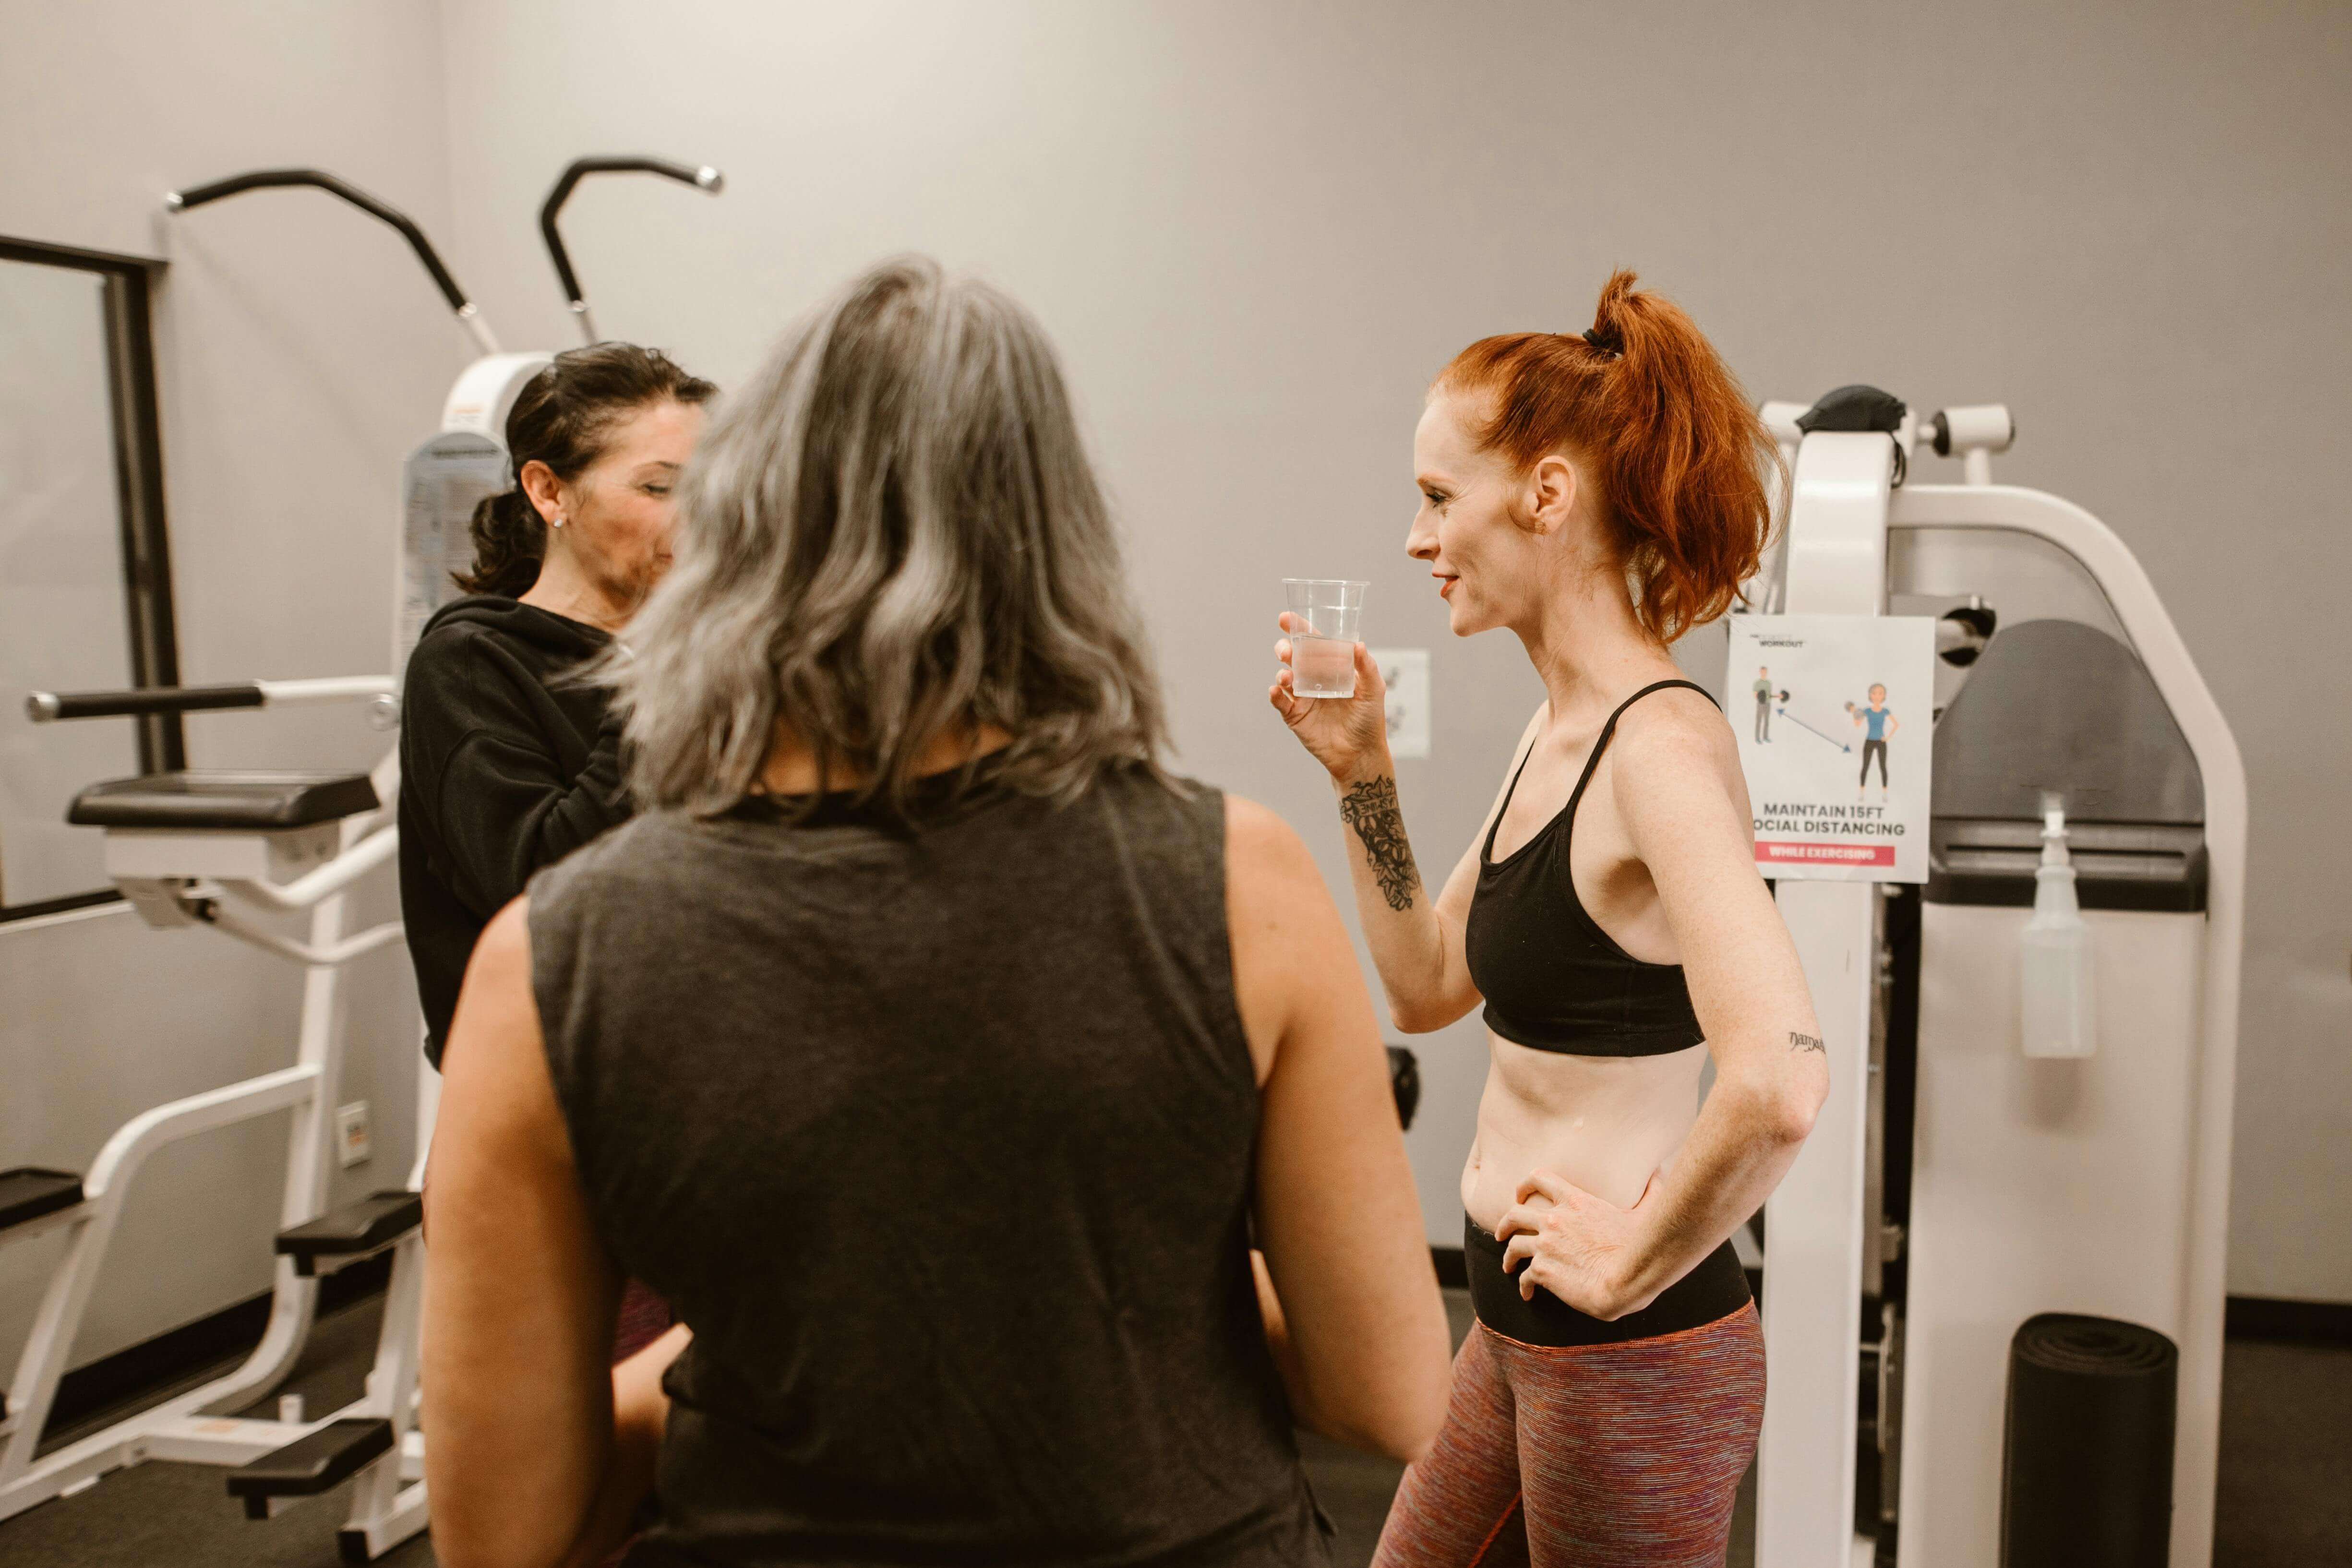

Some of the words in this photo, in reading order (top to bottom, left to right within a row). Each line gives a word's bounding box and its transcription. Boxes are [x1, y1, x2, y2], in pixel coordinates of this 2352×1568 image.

[1764, 803, 1846, 818] MAINTAIN
[1850, 805, 1884, 819] 15FT
[1754, 819, 1800, 832] OCIAL
[1804, 820, 1905, 836] DISTANCING
[1769, 845, 1805, 858] WHILE
[1807, 847, 1876, 860] EXERCISING
